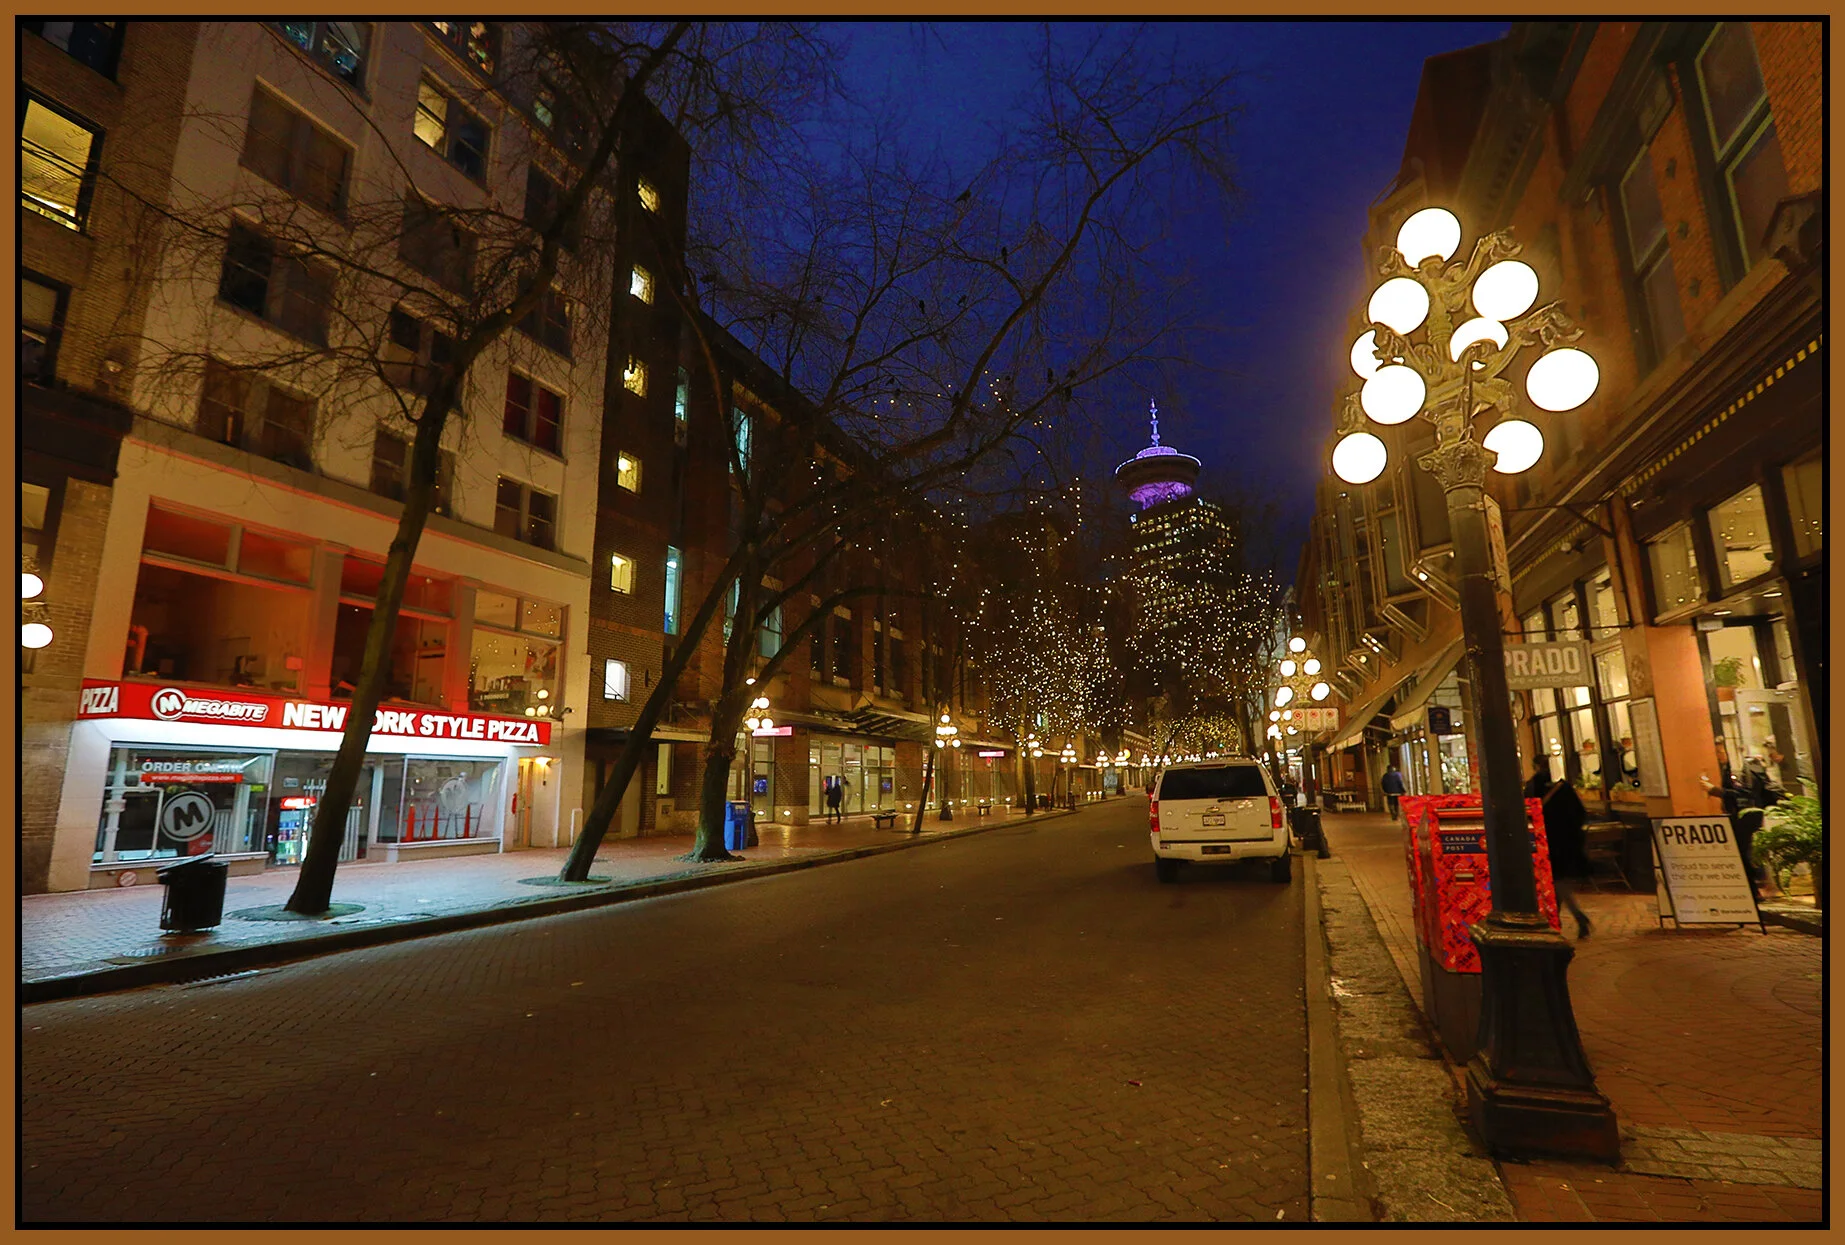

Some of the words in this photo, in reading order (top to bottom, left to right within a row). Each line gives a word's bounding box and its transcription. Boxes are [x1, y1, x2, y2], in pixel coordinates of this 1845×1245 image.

[80, 687, 119, 714] PIZZA
[182, 700, 266, 719] MEGABITE
[283, 703, 346, 729] NEW
[371, 710, 416, 734] ORK
[420, 715, 484, 739] STYLE
[488, 720, 539, 742] PIZZA
[142, 761, 191, 772] ORDER
[1661, 824, 1728, 845] PRADO
[1688, 873, 1704, 881] city
[1722, 873, 1742, 881] love
